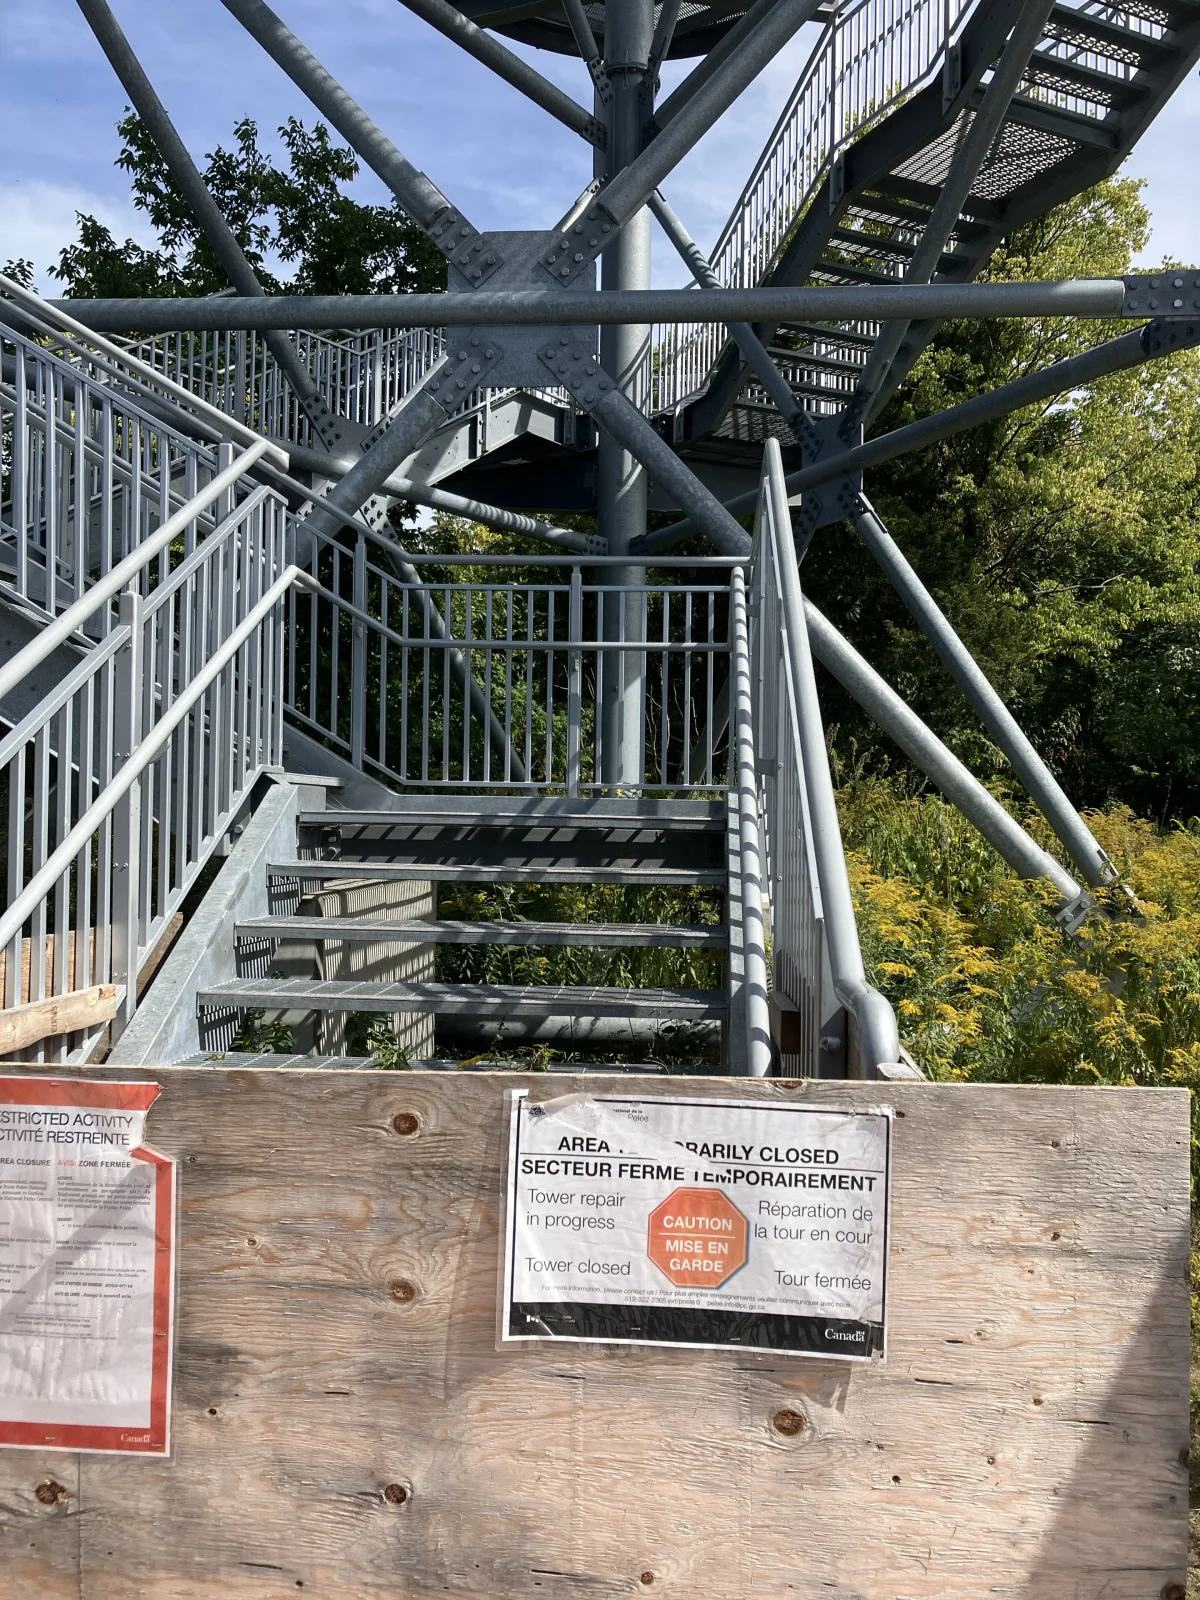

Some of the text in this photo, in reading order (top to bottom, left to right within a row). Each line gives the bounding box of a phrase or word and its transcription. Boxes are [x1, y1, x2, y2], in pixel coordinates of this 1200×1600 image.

[73, 1114, 133, 1128] ACTIVITY
[47, 1131, 130, 1146] RESTREINTE
[558, 1136, 610, 1153] AREA
[759, 1146, 839, 1165] CLOSED
[16, 1158, 51, 1166] CLOSURE
[100, 1160, 131, 1168] FERMÉE
[521, 1159, 612, 1178] SECTEUR
[528, 1188, 626, 1208] Tower repair
[526, 1208, 616, 1231] in progress
[758, 1200, 874, 1222] Réparation de
[662, 1215, 733, 1232] CAUTION
[754, 1222, 874, 1244] la tour en cour
[665, 1239, 729, 1254] MISE EN
[525, 1256, 631, 1276] Tower closed
[669, 1257, 724, 1272] GARDE
[774, 1270, 872, 1290] Tour fermée
[779, 1298, 820, 1306] communiquer
[824, 1328, 865, 1342] Canada
[120, 1433, 150, 1443] Canada
